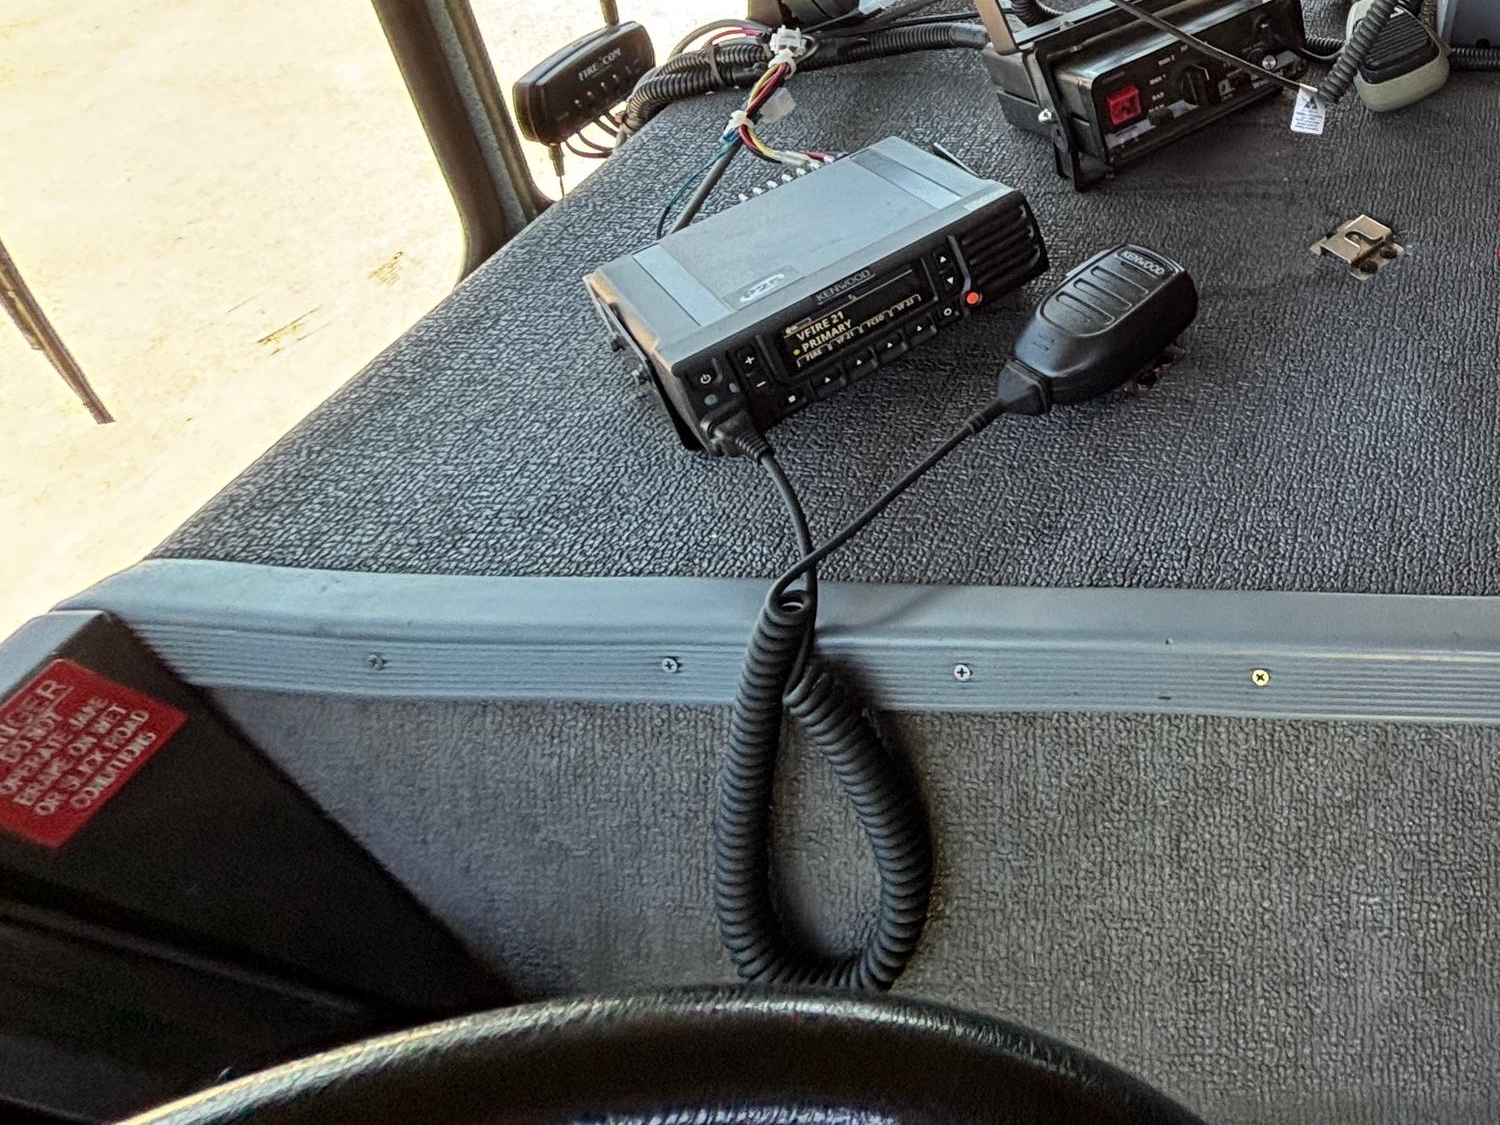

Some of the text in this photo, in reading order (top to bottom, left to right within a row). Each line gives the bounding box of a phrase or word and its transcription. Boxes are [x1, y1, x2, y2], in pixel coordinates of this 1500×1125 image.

[1120, 250, 1165, 275] KENWOOD
[815, 269, 872, 302] KENWOOD
[796, 311, 844, 341] VFIRE 21
[802, 318, 852, 353] PRIMARY
[27, 710, 64, 742] NOT
[67, 734, 98, 756] ON
[0, 730, 74, 795] OPERATE
[33, 791, 66, 816] OR
[102, 709, 150, 750] ROAD
[69, 731, 157, 809] CONDITIONS
